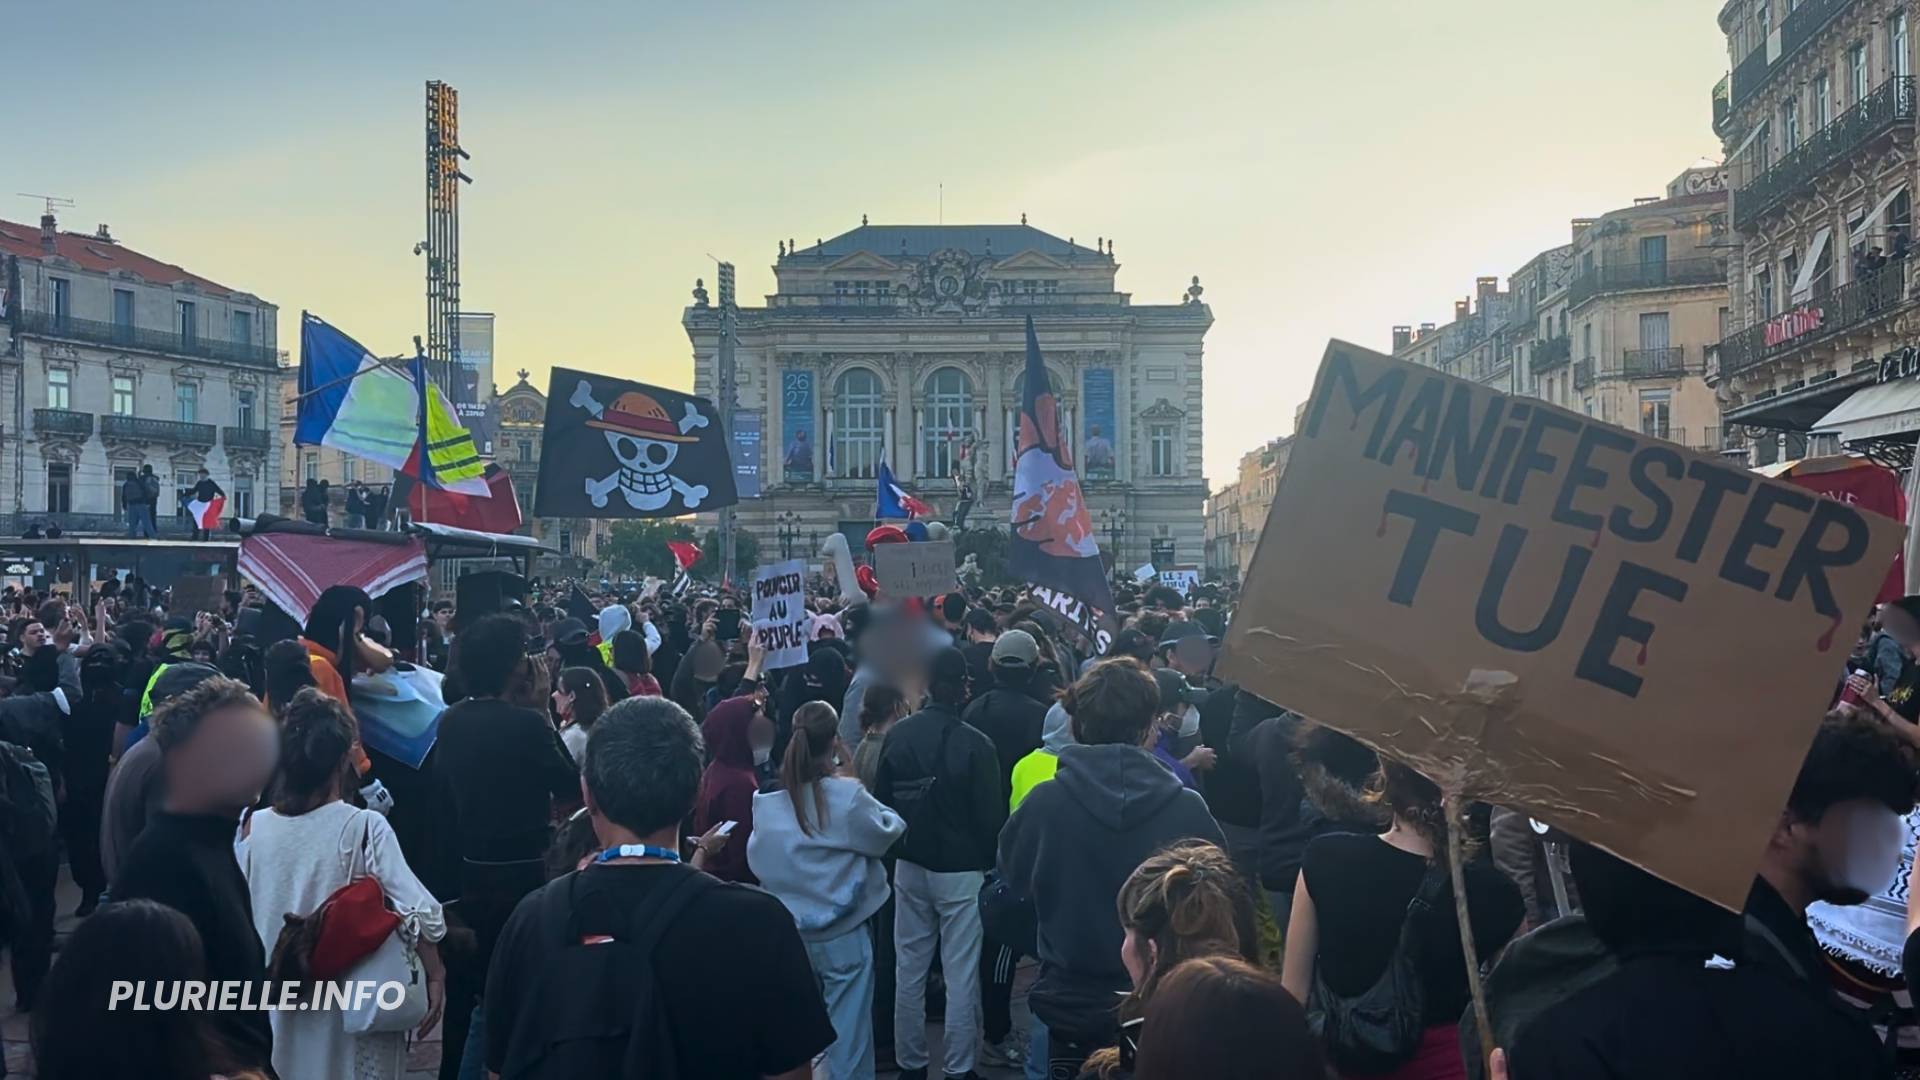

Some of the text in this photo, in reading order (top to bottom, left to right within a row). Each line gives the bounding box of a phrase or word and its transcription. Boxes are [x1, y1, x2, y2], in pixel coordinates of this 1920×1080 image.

[786, 374, 809, 390] 26
[786, 390, 809, 407] 27
[1384, 489, 1688, 698] TUE
[768, 600, 788, 621] AU
[758, 621, 803, 651] PEUPLE
